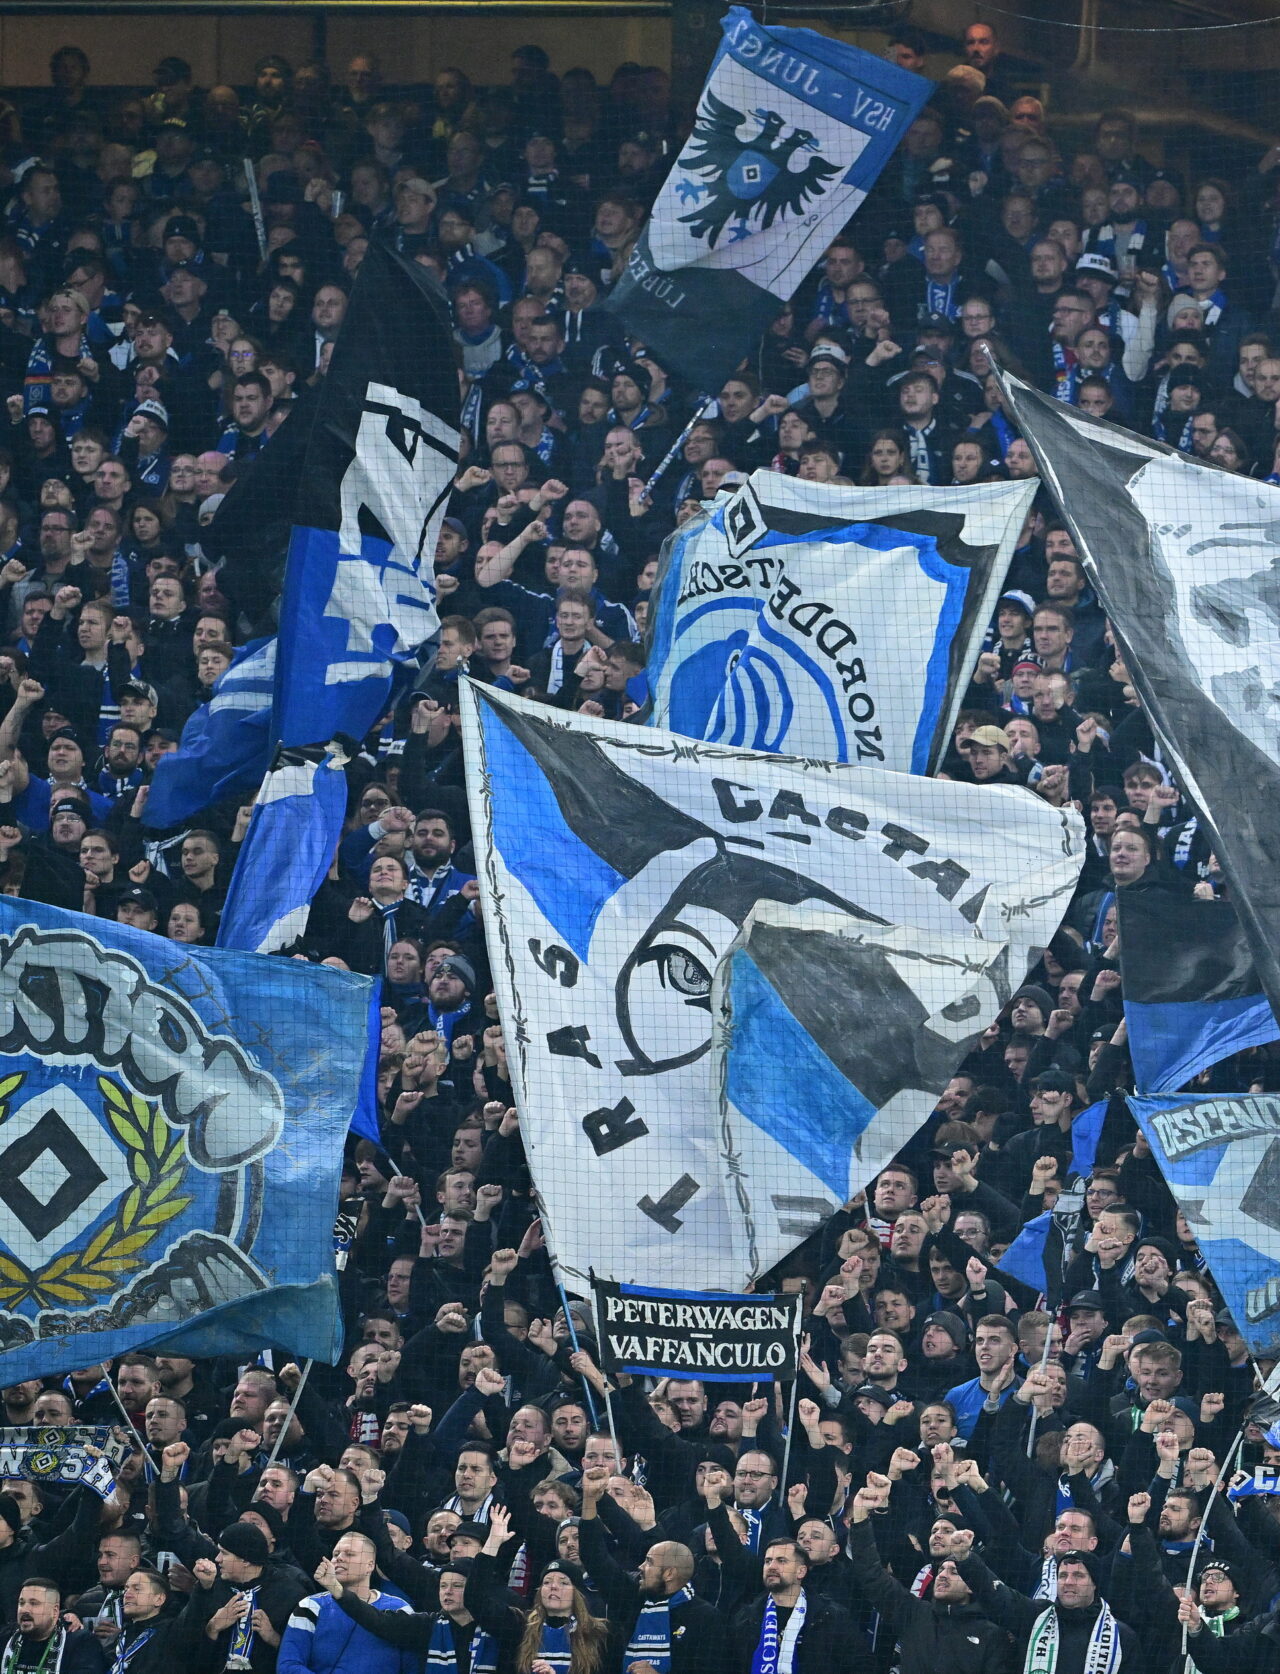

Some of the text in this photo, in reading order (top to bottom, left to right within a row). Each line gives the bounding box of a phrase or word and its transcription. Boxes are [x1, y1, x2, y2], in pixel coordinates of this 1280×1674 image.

[606, 1296, 790, 1330] PETERWAGEN
[608, 1334, 786, 1368] VAFFANCULO
[637, 1633, 667, 1641] CASTAWAYS
